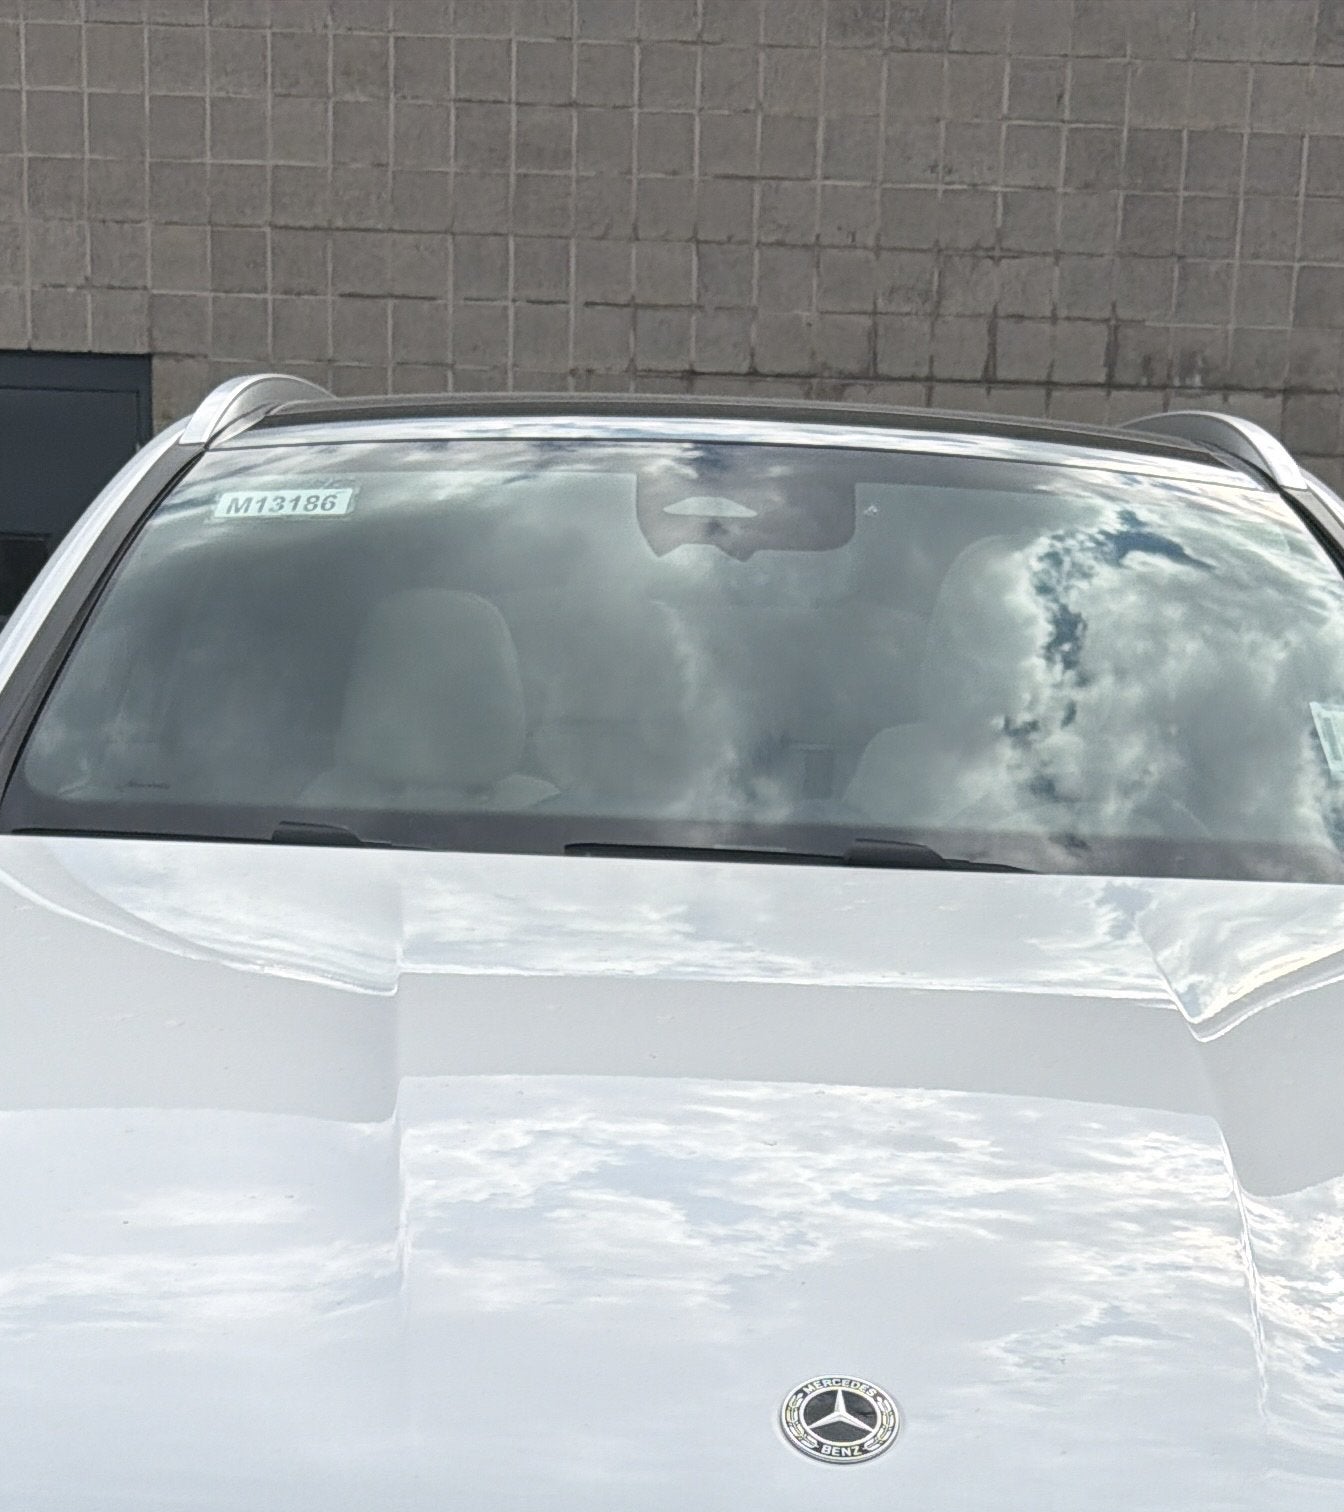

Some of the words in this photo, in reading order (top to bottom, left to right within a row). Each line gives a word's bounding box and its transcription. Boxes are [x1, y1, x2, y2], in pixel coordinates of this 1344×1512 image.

[226, 494, 338, 514] M13186
[803, 1378, 876, 1395] MERCEDES
[821, 1445, 862, 1456] BENZ
